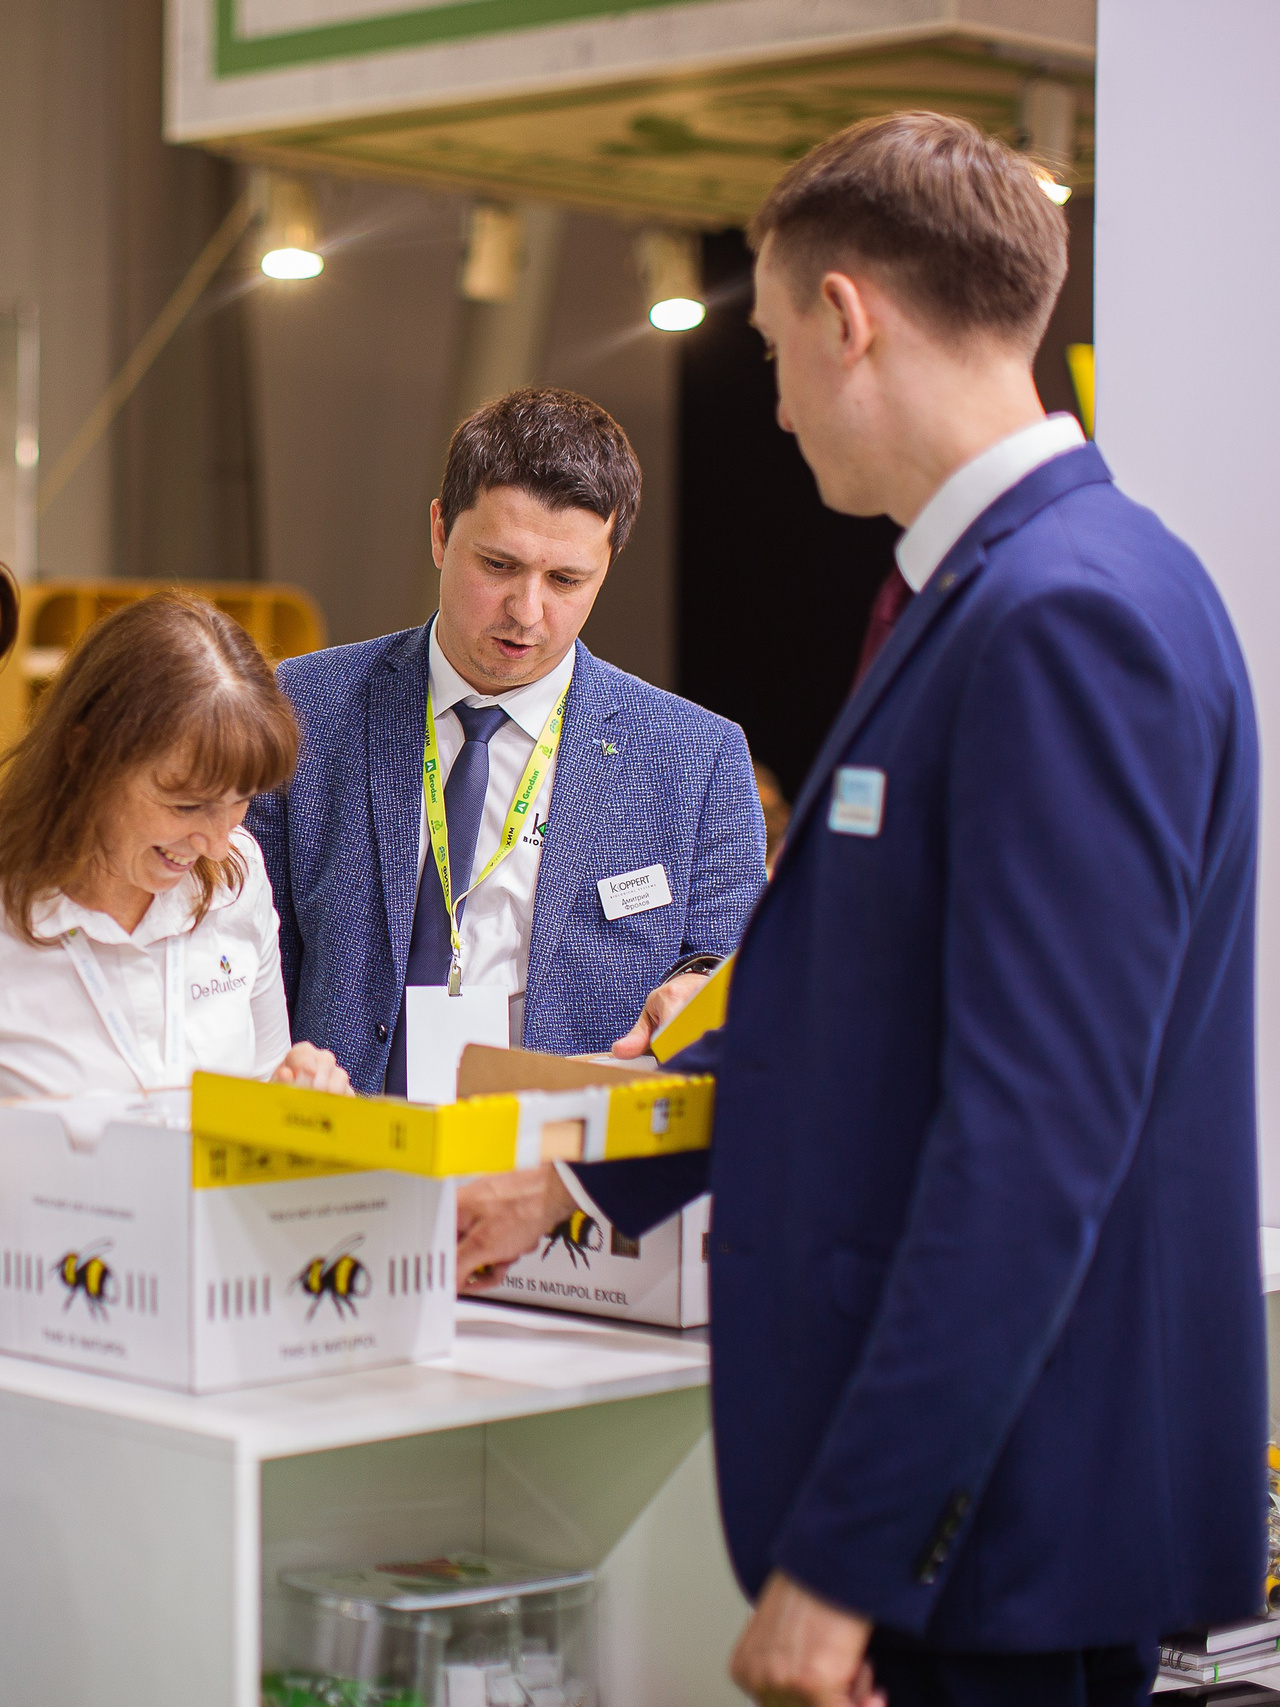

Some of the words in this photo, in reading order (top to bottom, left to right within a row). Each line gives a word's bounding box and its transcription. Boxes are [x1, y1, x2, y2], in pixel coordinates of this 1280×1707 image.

[428, 773, 437, 804] Grodan
[522, 769, 540, 800] Grodan
[621, 892, 650, 906] Дмитрий
[624, 901, 650, 911] Фролов
[526, 1279, 537, 1292] IS
[540, 1281, 592, 1300] NATUPOL
[594, 1288, 629, 1306] EXCEL
